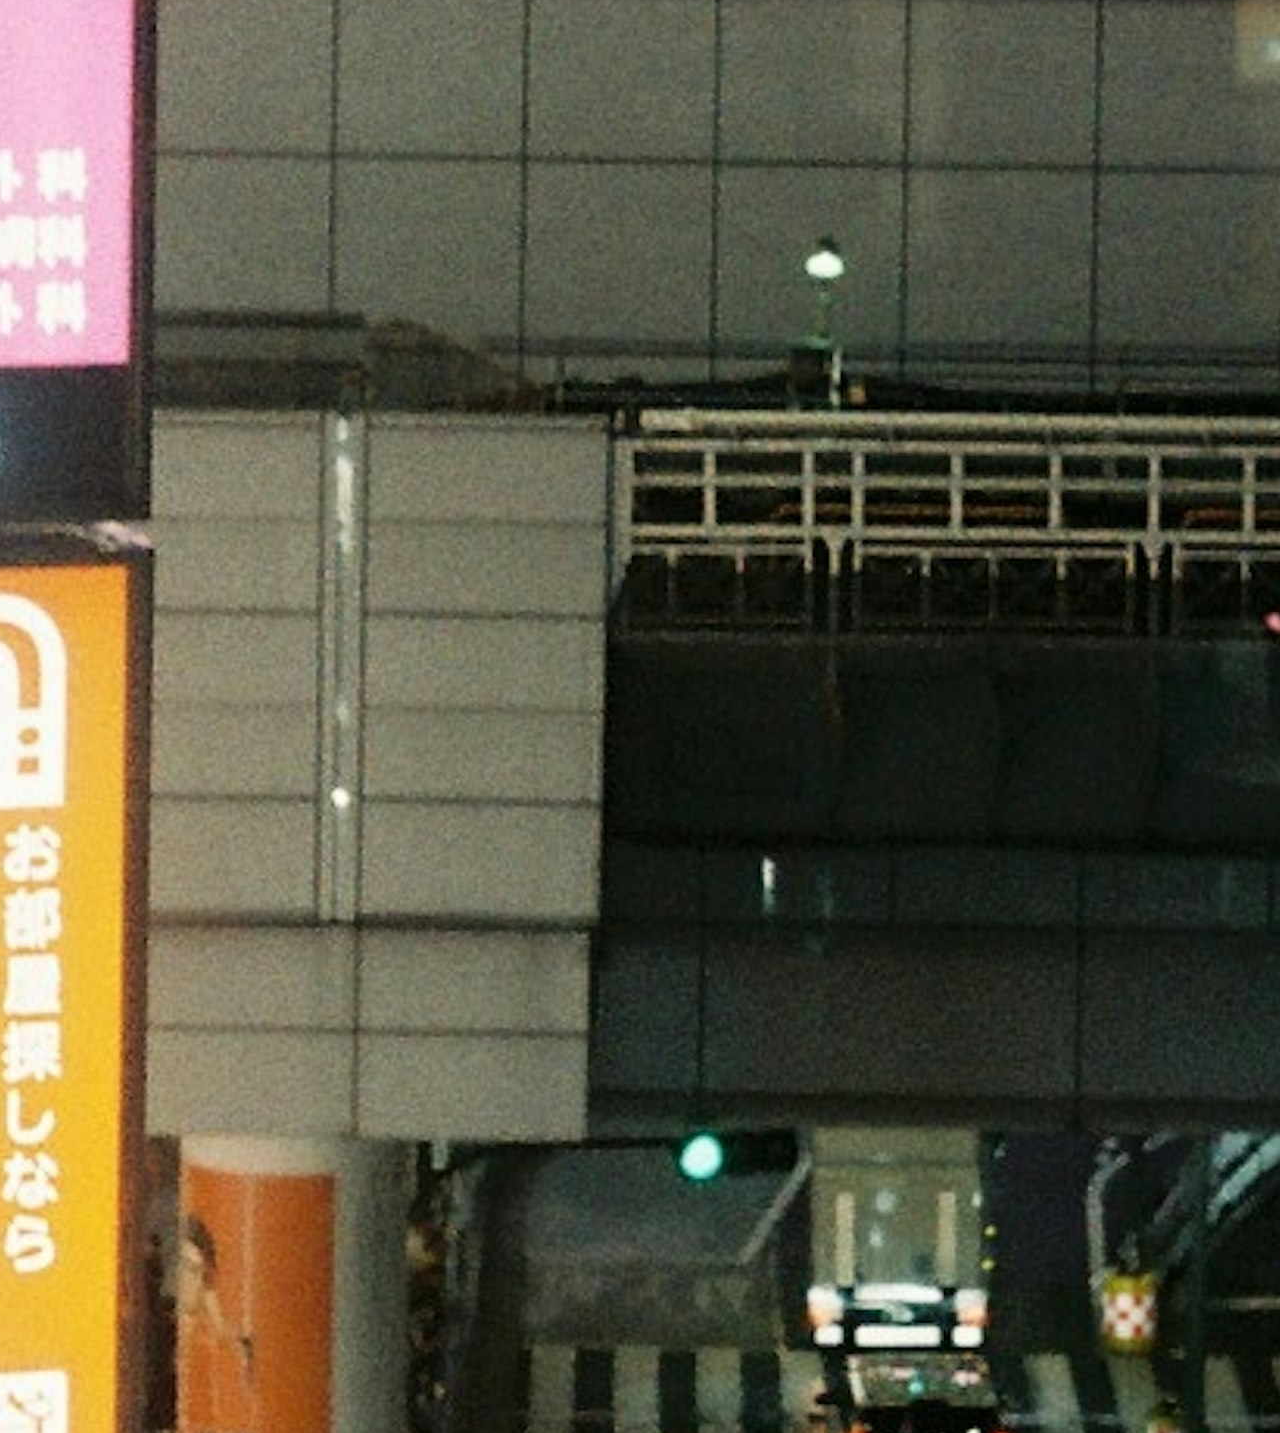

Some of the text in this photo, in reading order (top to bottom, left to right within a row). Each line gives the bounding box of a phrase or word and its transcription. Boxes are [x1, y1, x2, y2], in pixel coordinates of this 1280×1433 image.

[2, 823, 63, 1275] お部屋探しなら
